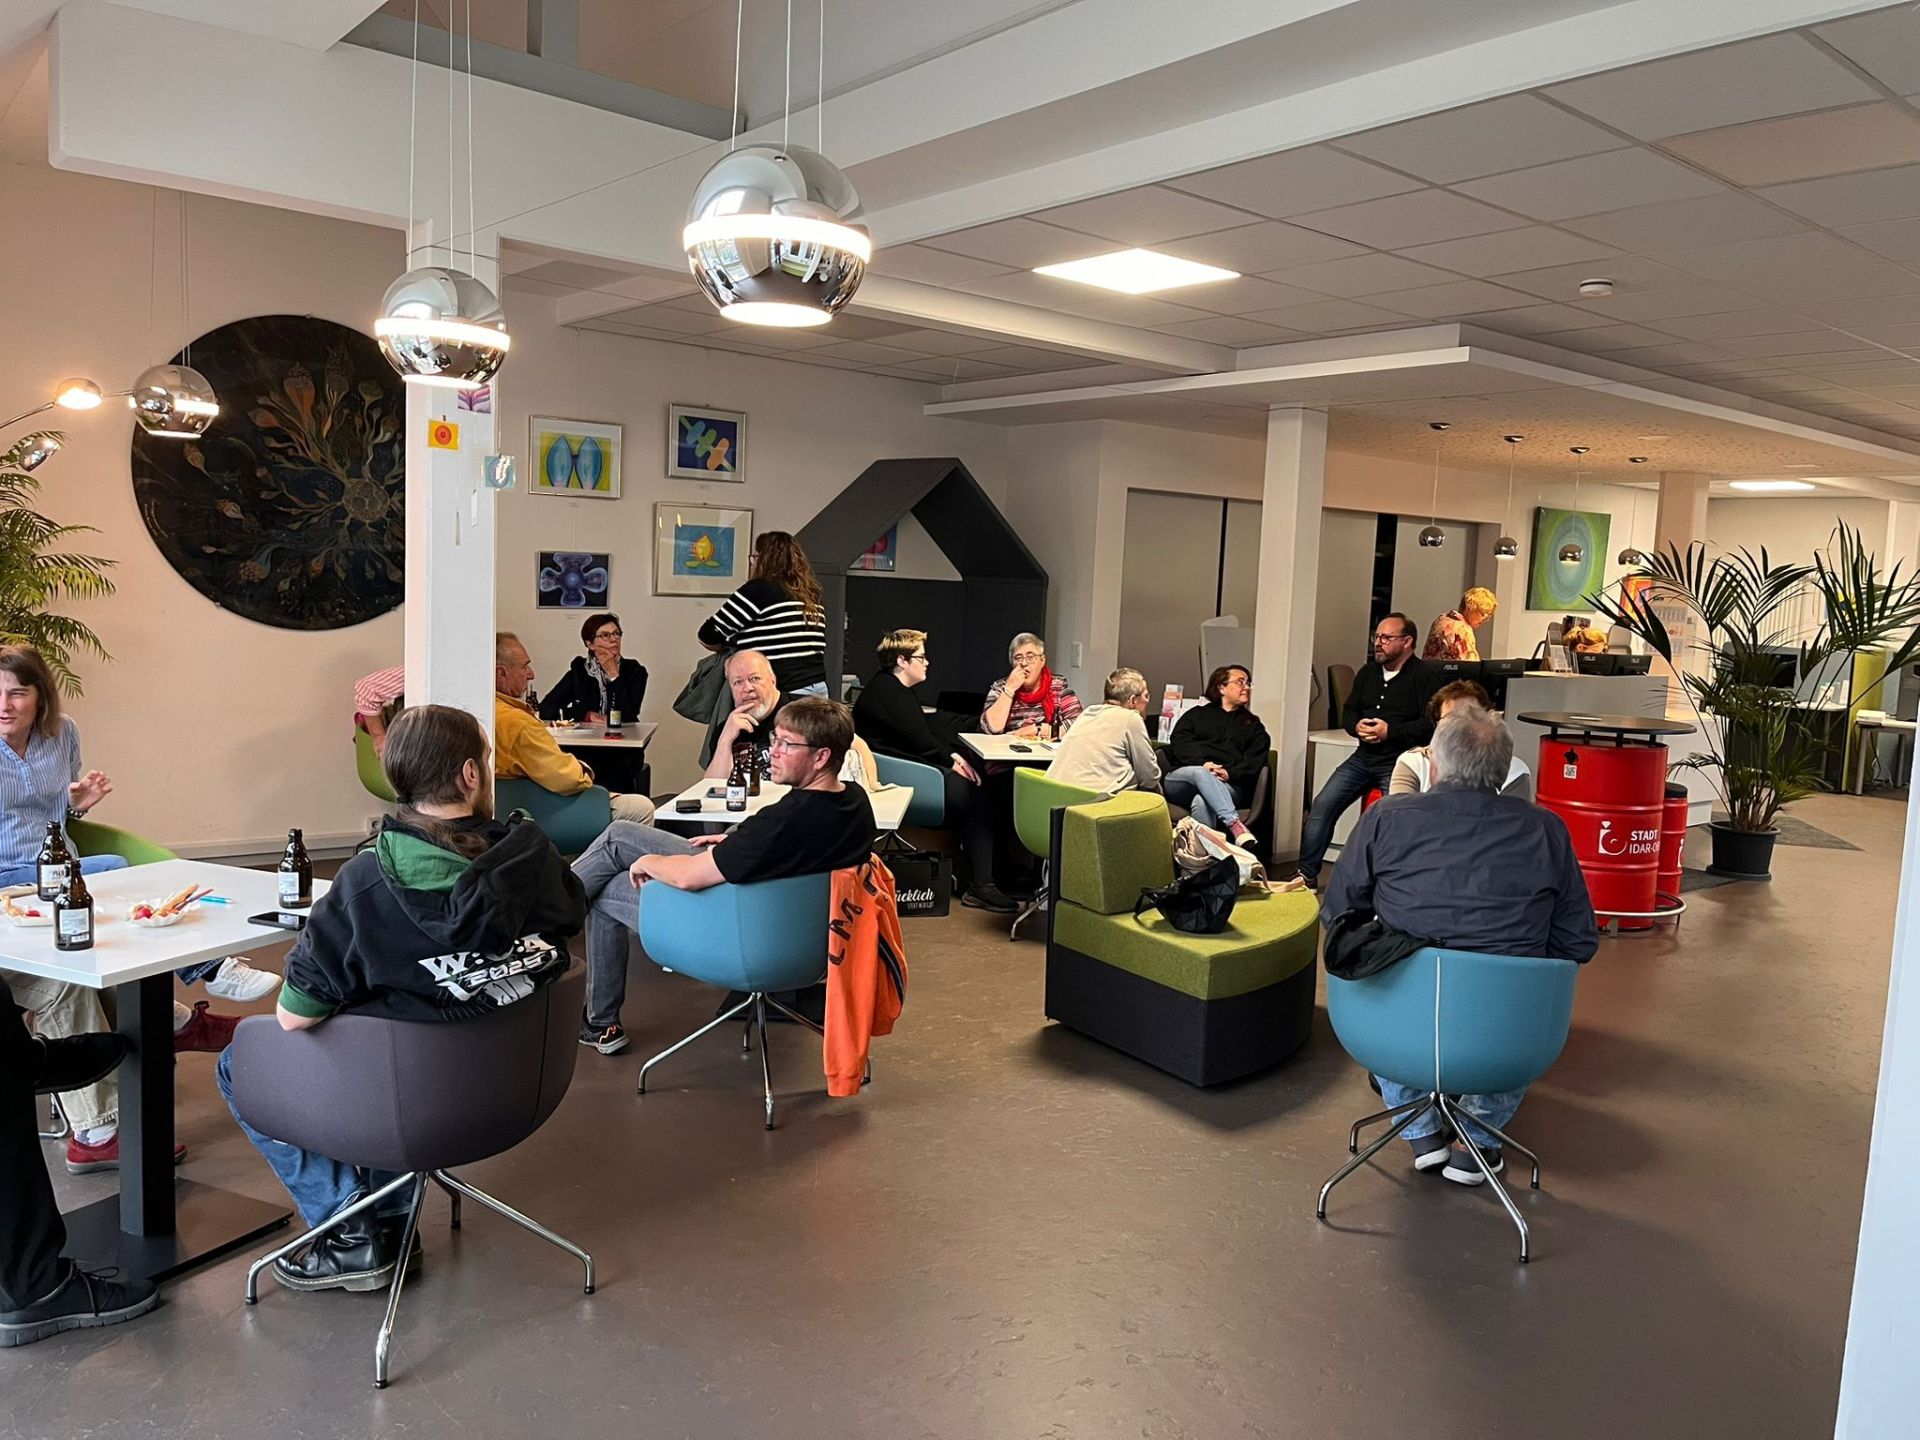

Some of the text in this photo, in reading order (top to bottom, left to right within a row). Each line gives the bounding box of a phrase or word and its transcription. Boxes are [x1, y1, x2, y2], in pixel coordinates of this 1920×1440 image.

[1631, 829, 1658, 841] STADT
[896, 888, 934, 902] ücklich
[462, 951, 547, 988] 2025
